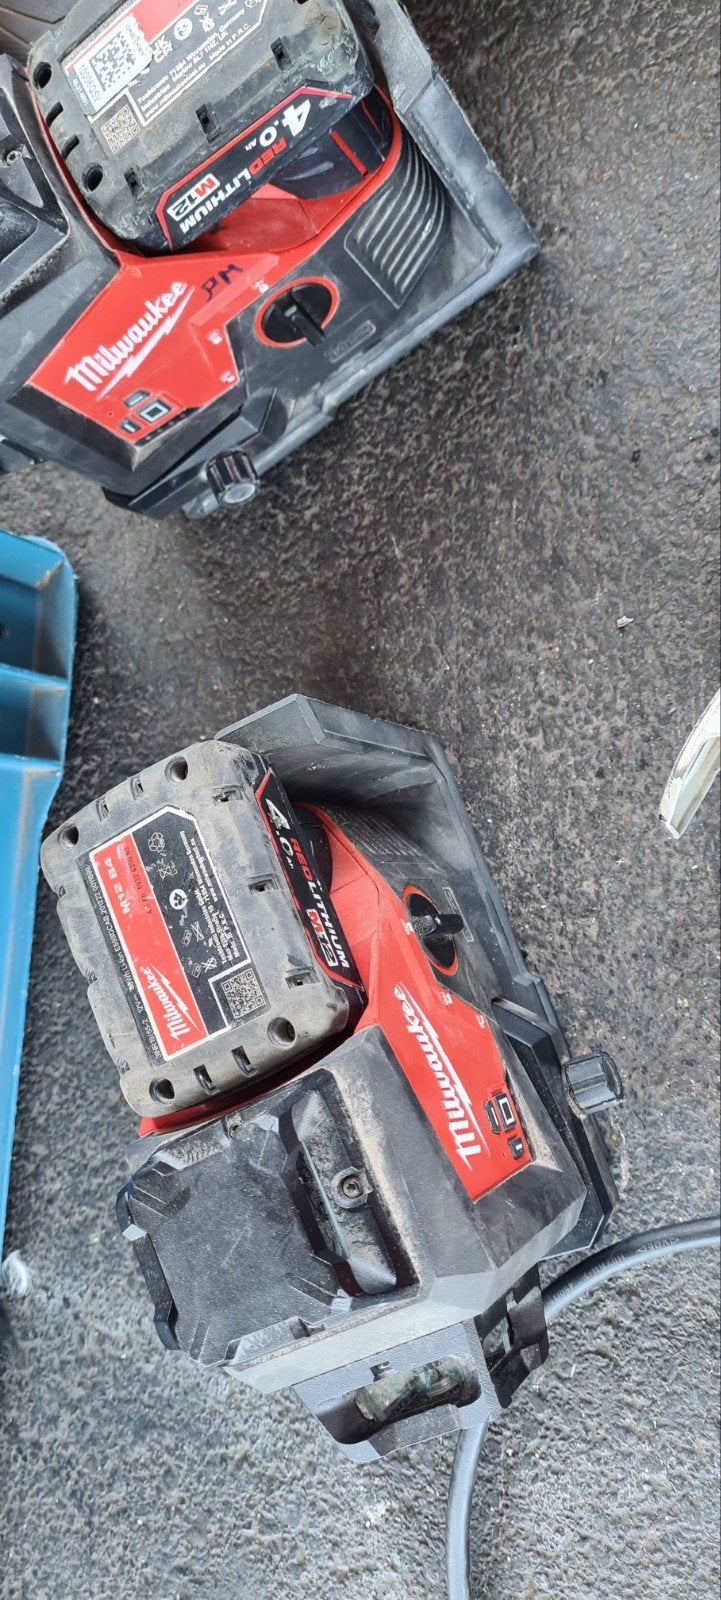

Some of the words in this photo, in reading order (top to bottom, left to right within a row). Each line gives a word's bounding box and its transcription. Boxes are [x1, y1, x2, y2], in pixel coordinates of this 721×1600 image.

[259, 99, 311, 147] 4.0
[170, 176, 218, 218] M12
[179, 138, 288, 233] REDLITHIUM
[64, 281, 188, 391] Milwaukee
[265, 799, 294, 857] 4.0
[104, 856, 118, 880] B4
[113, 881, 131, 915] M12
[290, 837, 350, 968] REDLITHIUM
[307, 910, 337, 966] M12
[141, 967, 190, 1041] Milwaukee
[393, 984, 483, 1172] Milwaukee
